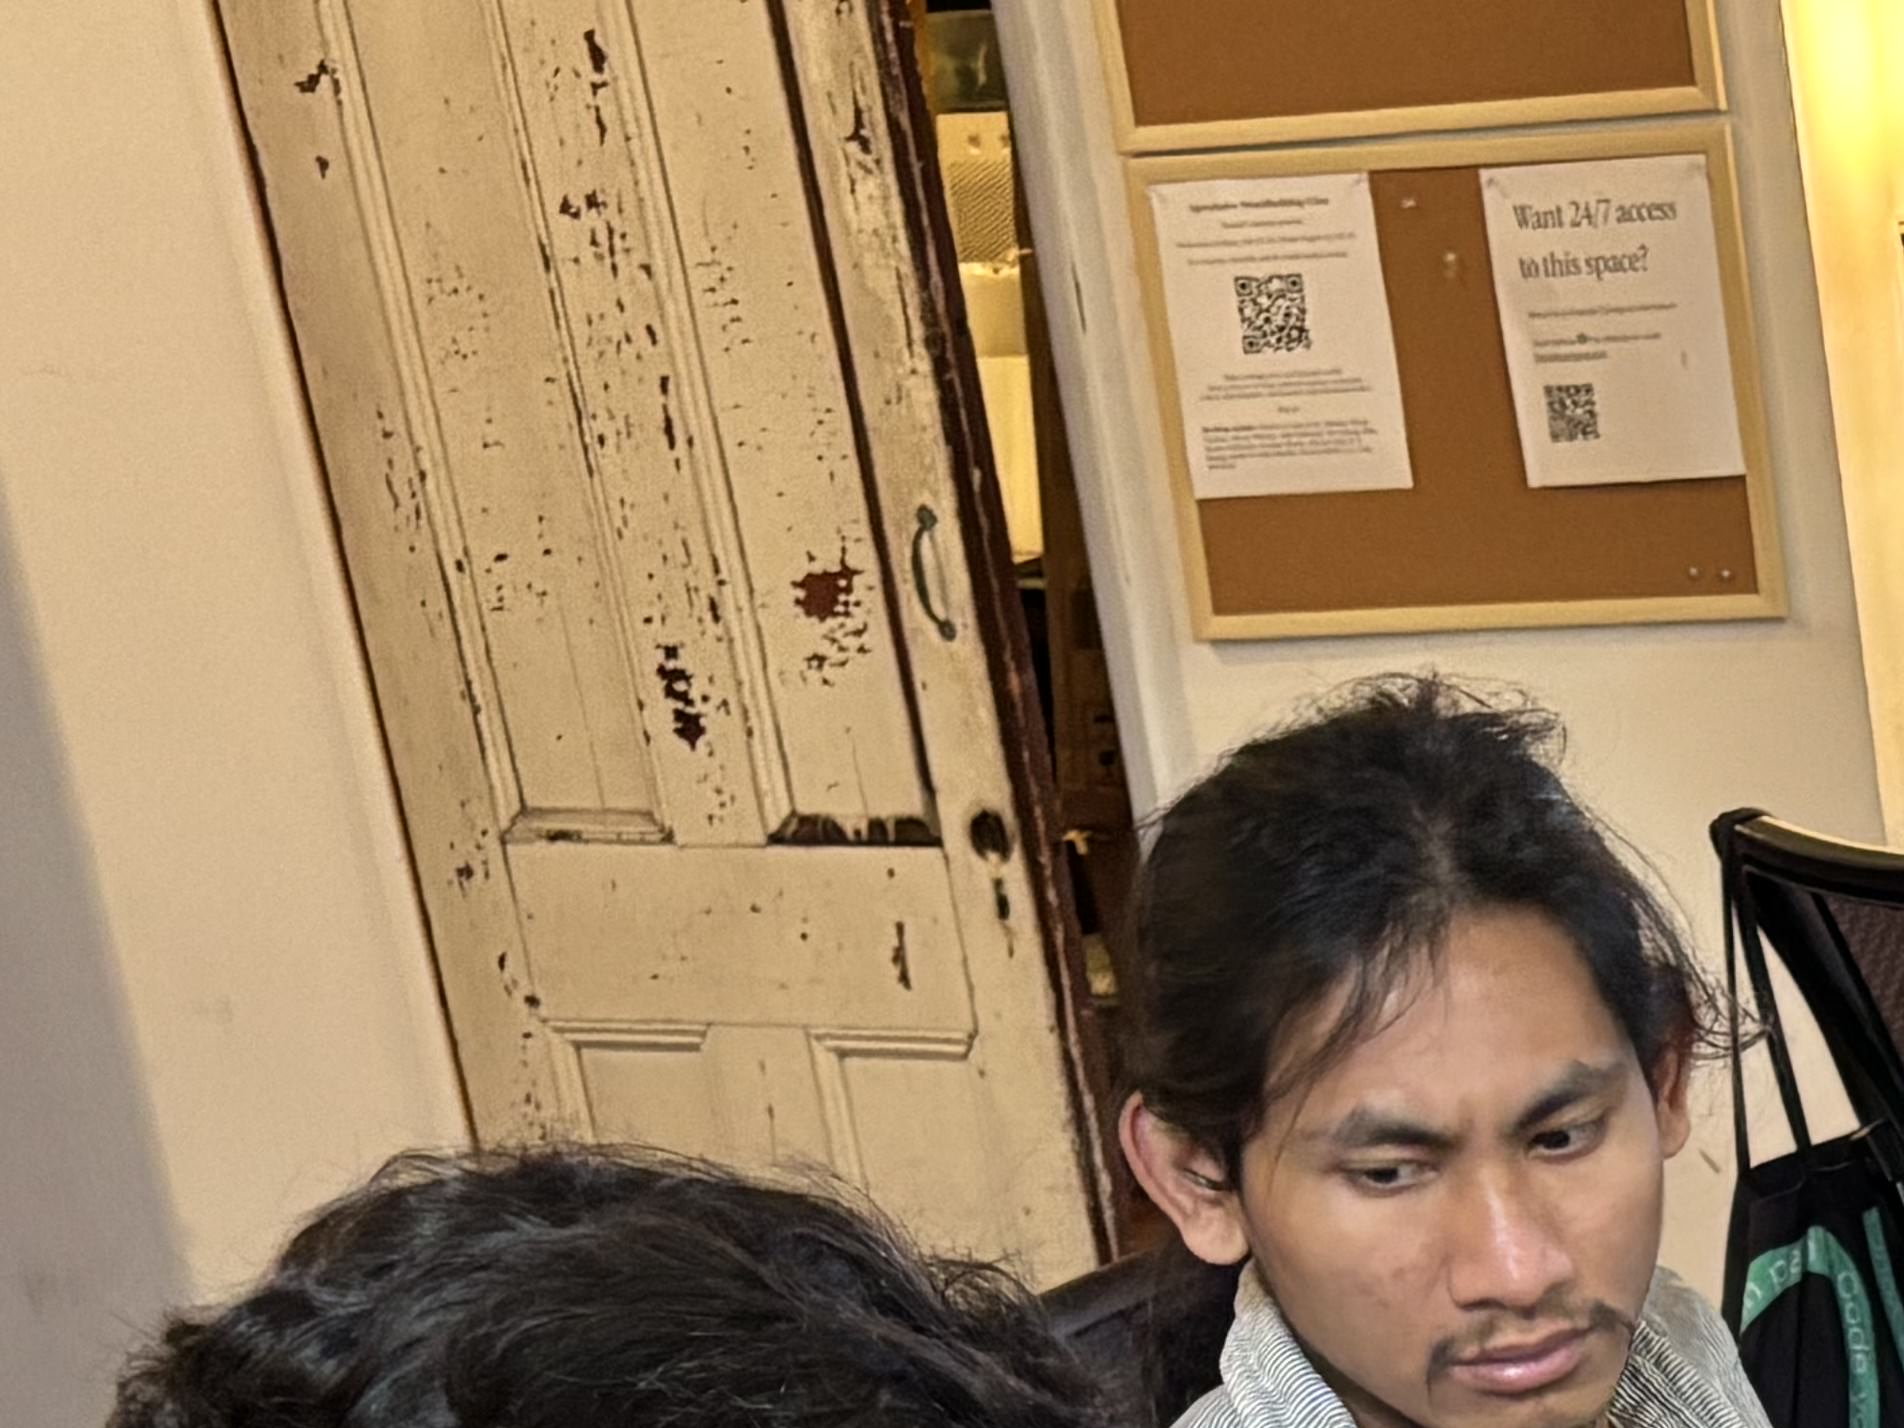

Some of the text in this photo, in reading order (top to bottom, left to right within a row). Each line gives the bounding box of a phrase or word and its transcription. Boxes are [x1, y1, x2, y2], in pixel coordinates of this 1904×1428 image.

[1513, 199, 1677, 230] Want 24/7 access
[1519, 243, 1648, 281] to this space?
